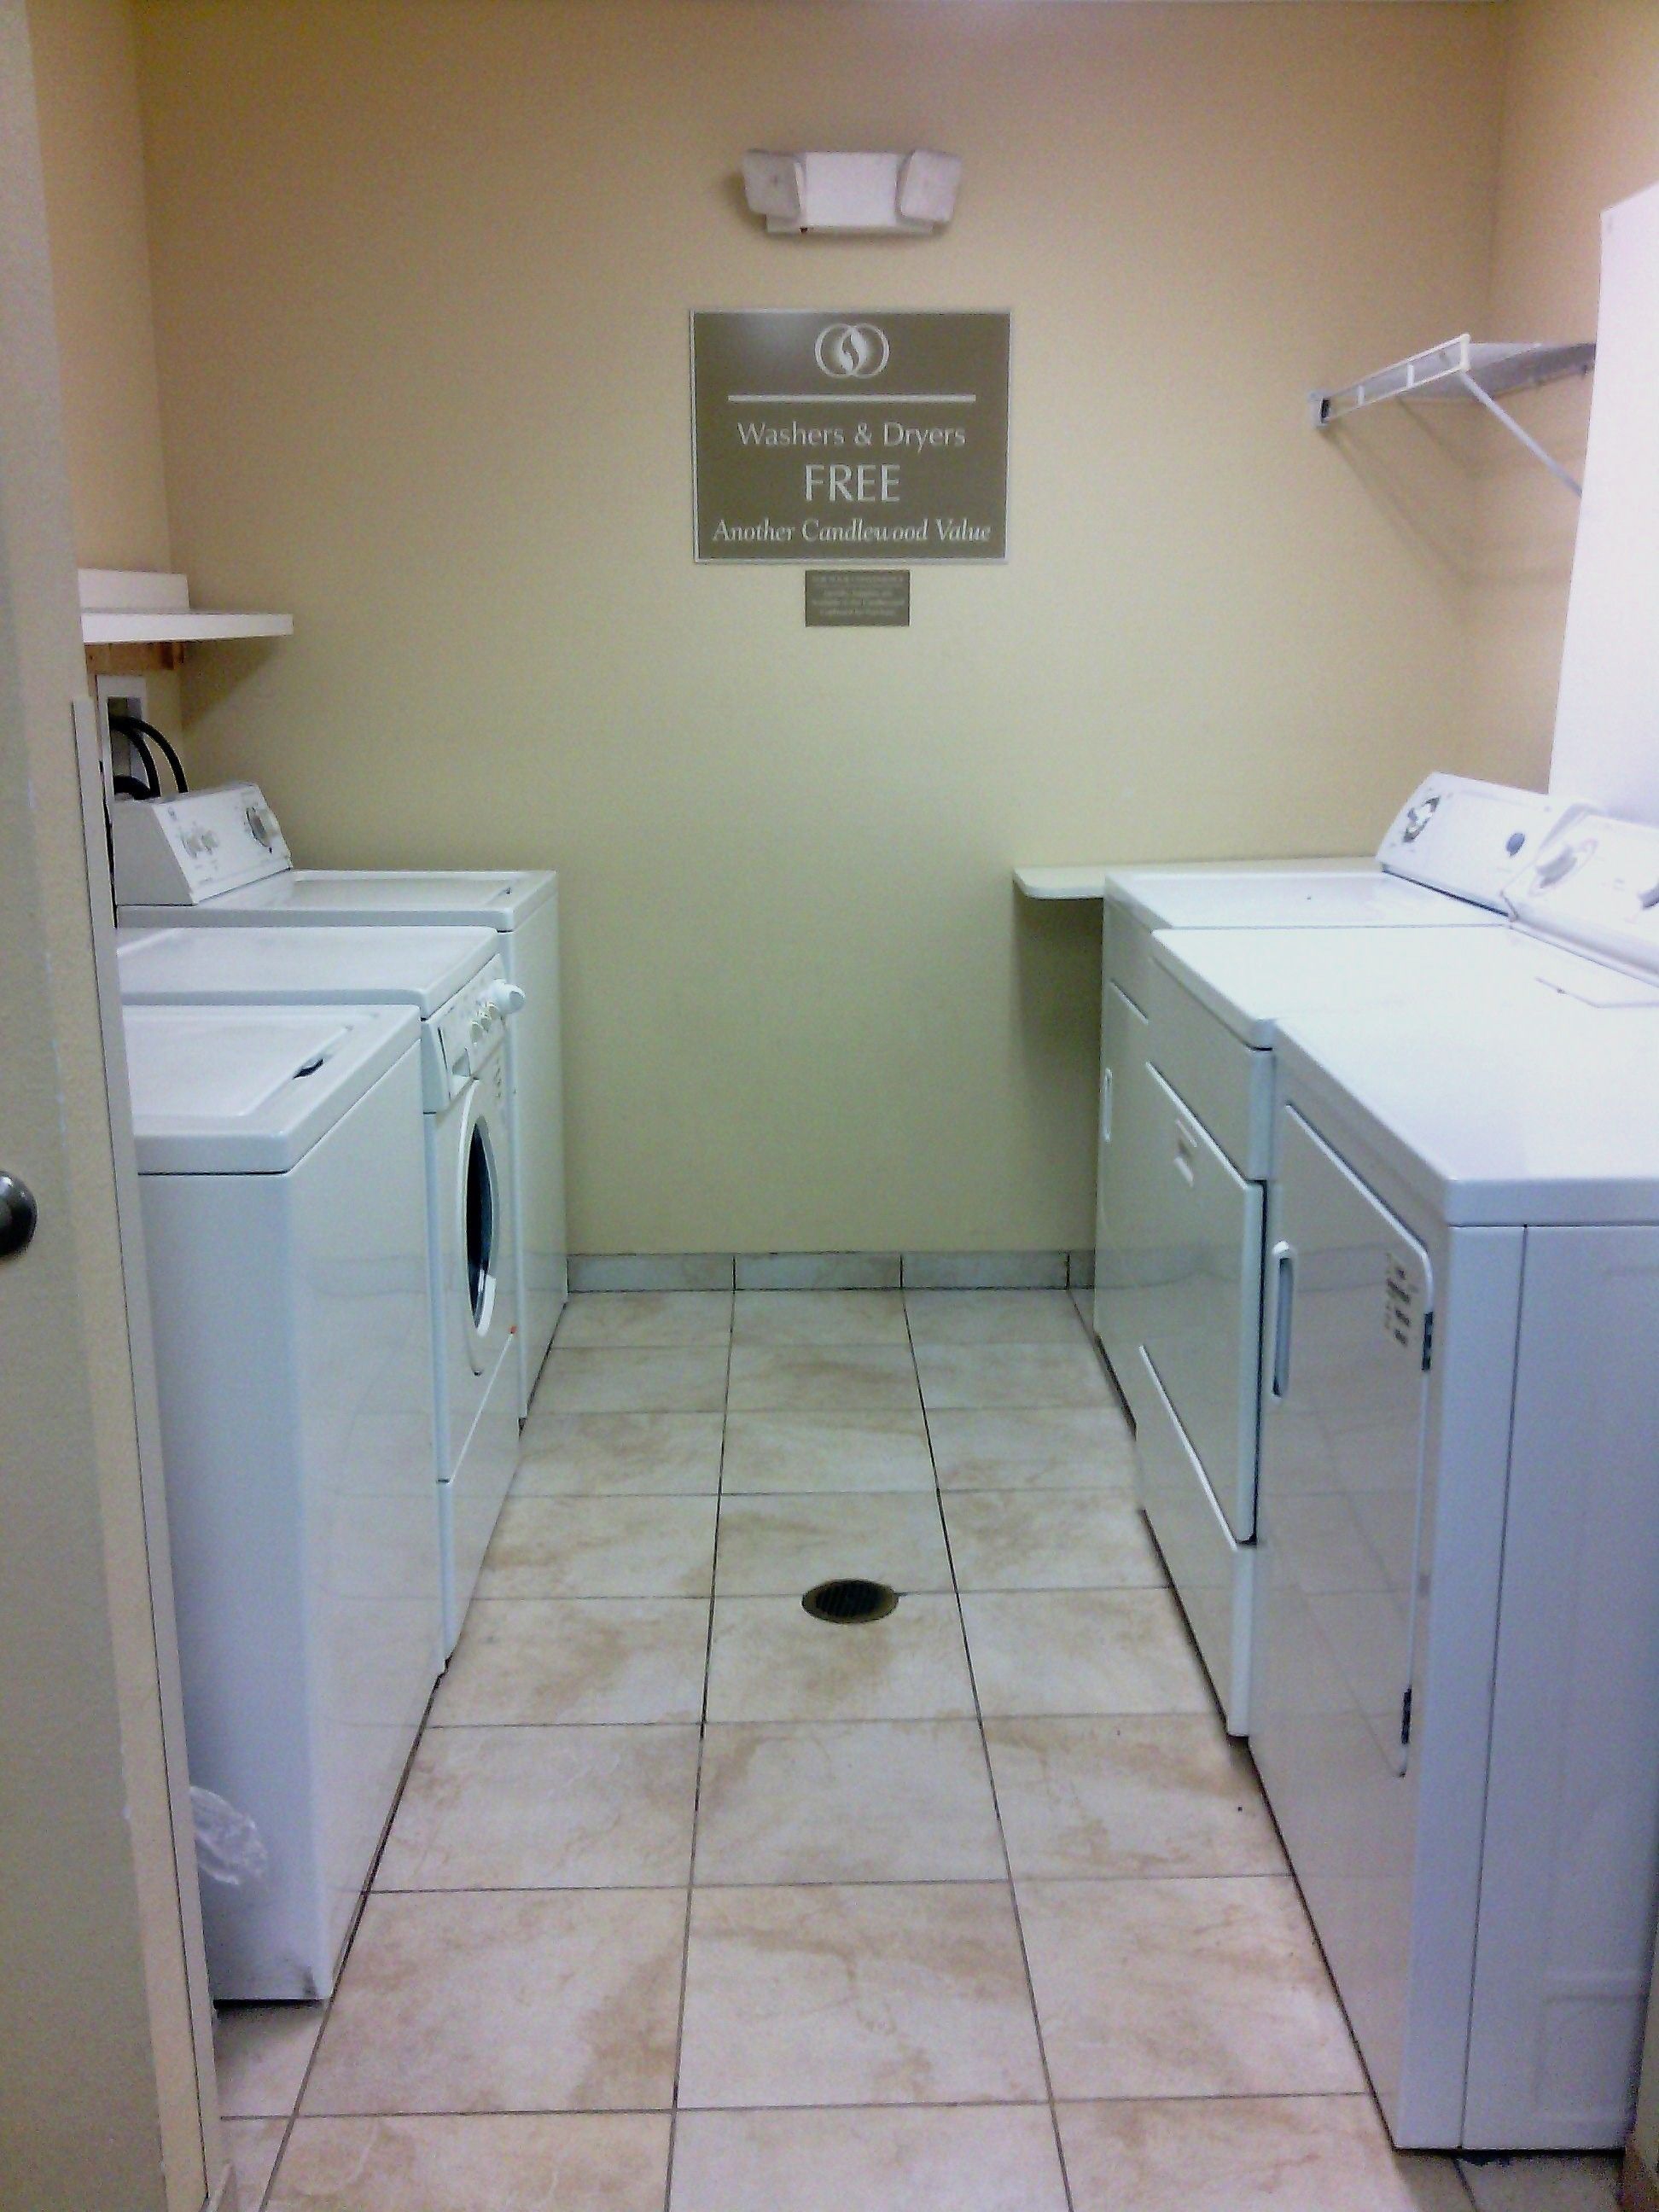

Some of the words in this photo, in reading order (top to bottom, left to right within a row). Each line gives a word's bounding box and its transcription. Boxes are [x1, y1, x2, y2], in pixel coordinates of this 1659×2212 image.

[737, 422, 845, 446] Washers
[853, 422, 872, 446] &
[883, 422, 966, 454] Dryers
[805, 464, 901, 502] FREE
[713, 518, 795, 542] Another
[802, 517, 928, 542] Candlewood
[935, 519, 992, 542] Value
